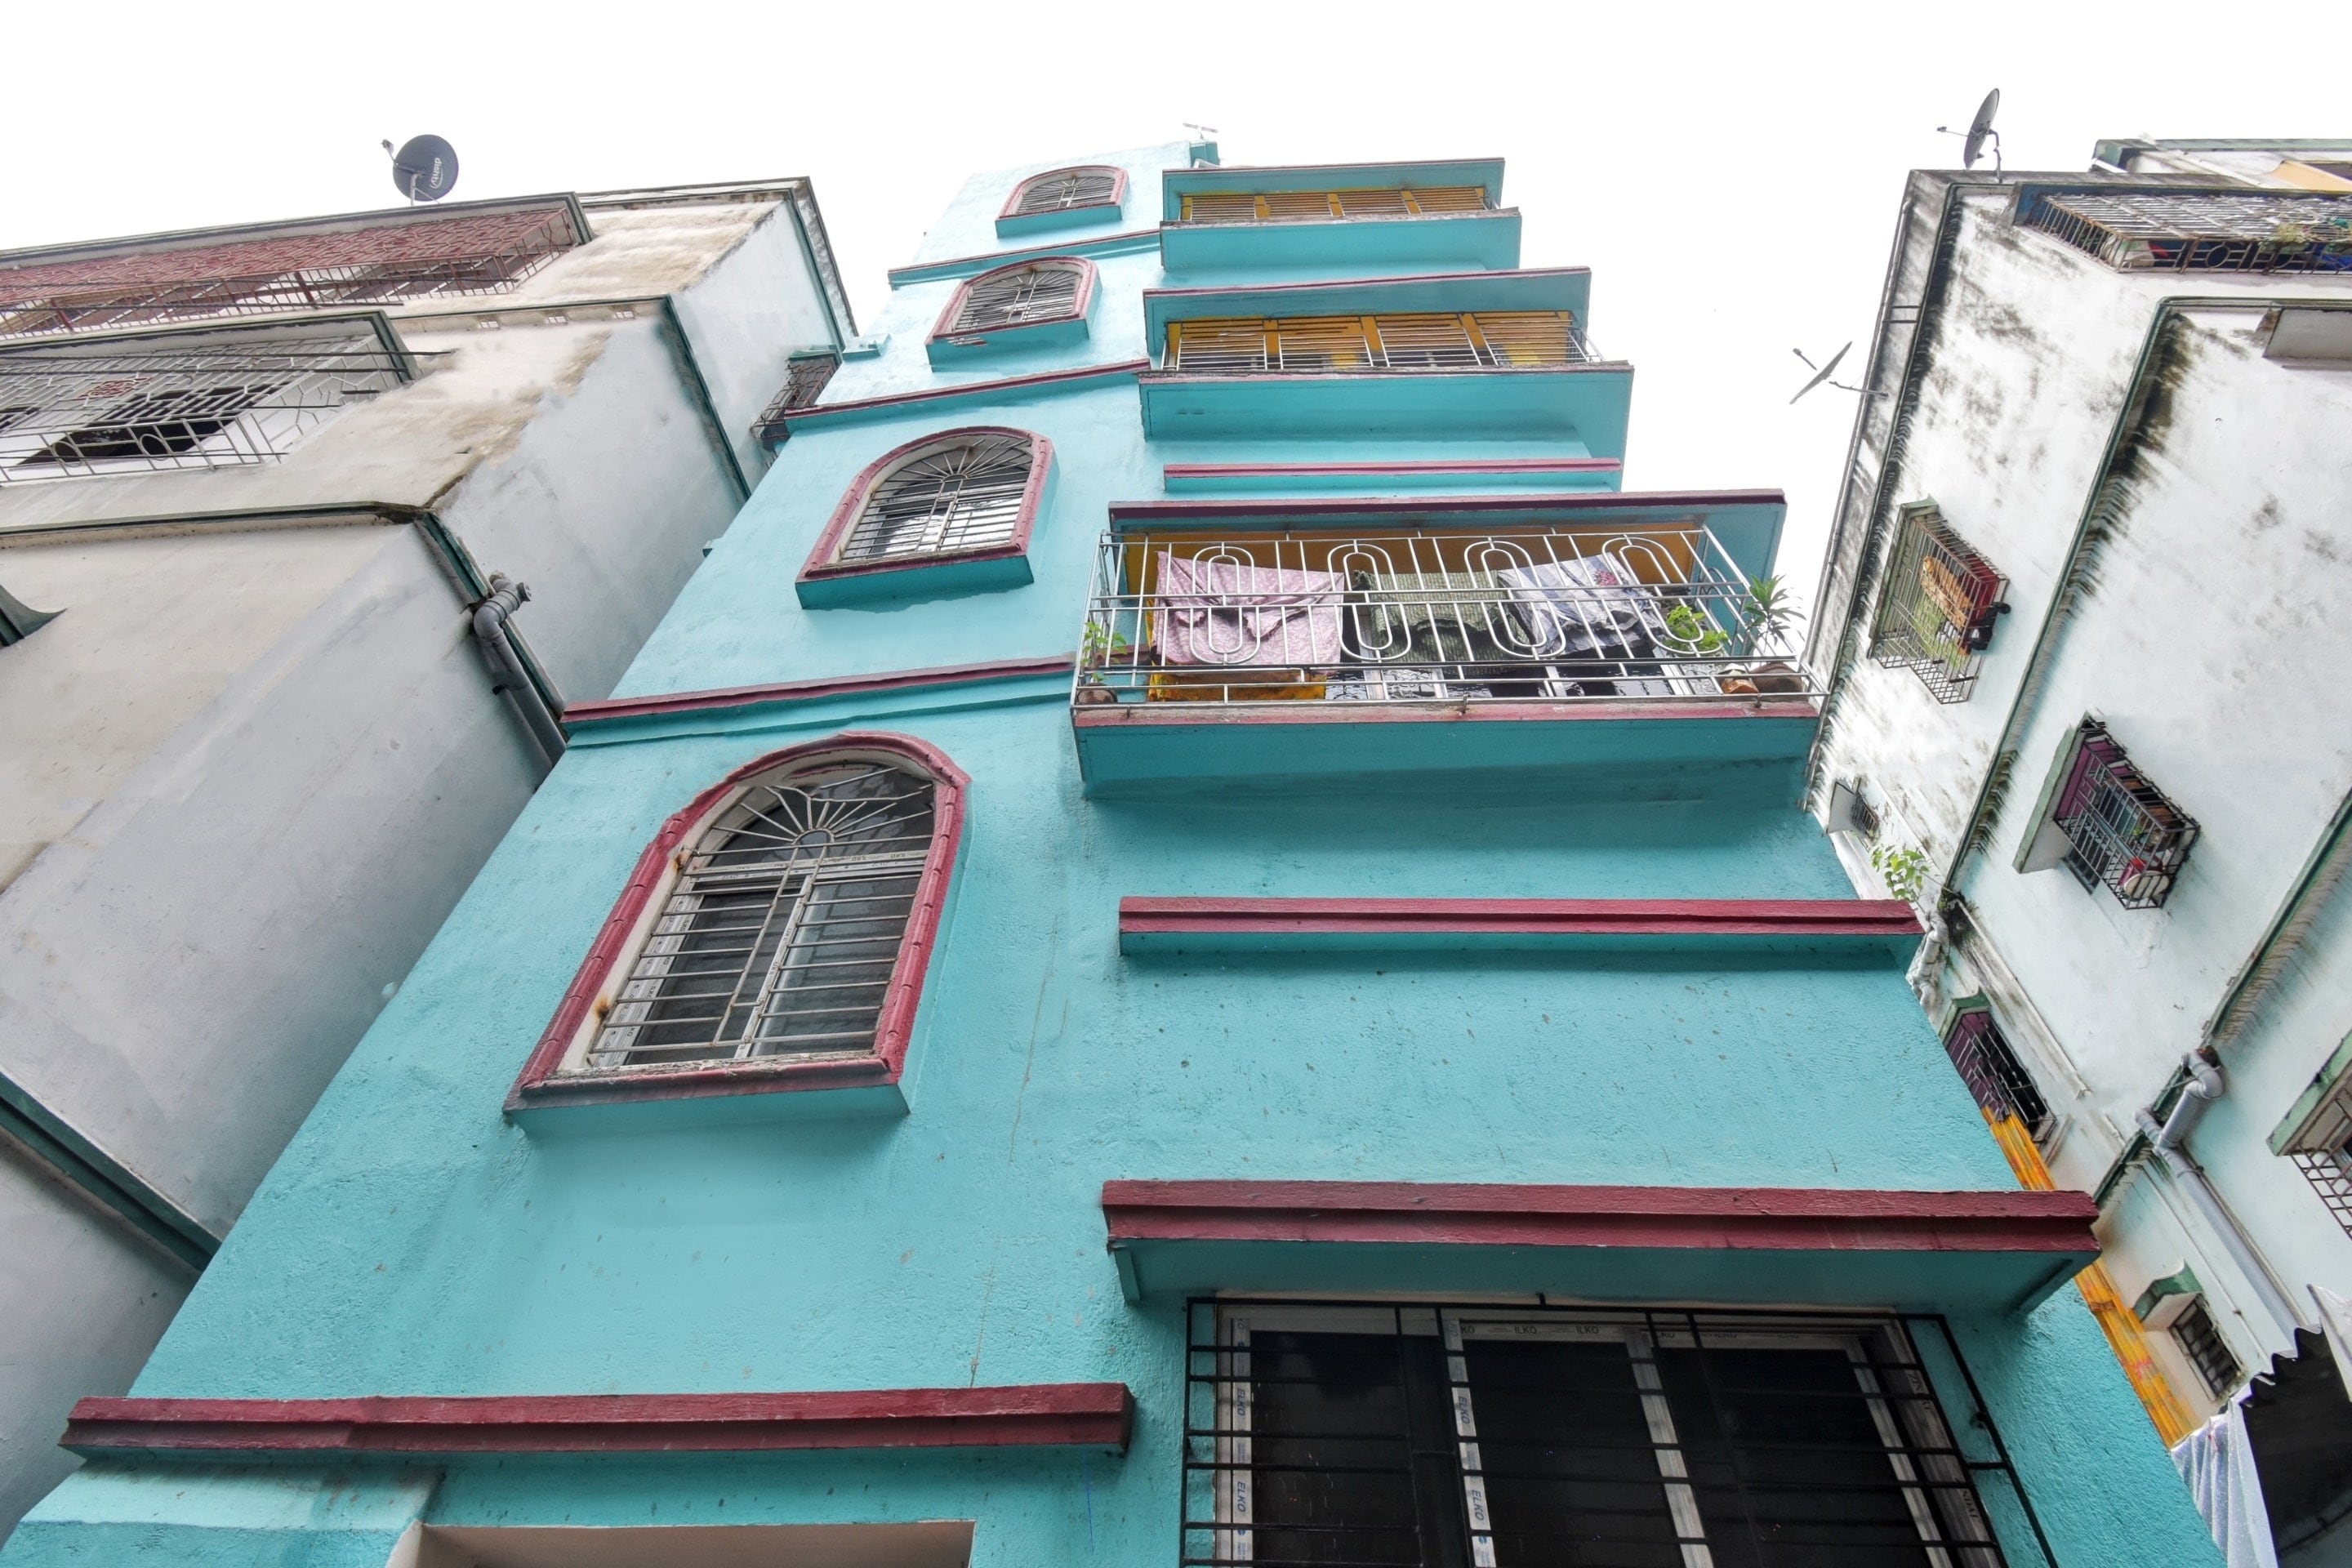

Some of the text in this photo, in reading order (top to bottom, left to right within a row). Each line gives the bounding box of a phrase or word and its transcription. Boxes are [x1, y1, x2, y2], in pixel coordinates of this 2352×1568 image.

[1236, 1388, 1246, 1417] ELKO
[1458, 1396, 1470, 1424] ELKO
[1236, 1481, 1246, 1512] ELKO
[1471, 1489, 1485, 1521] ELKO
